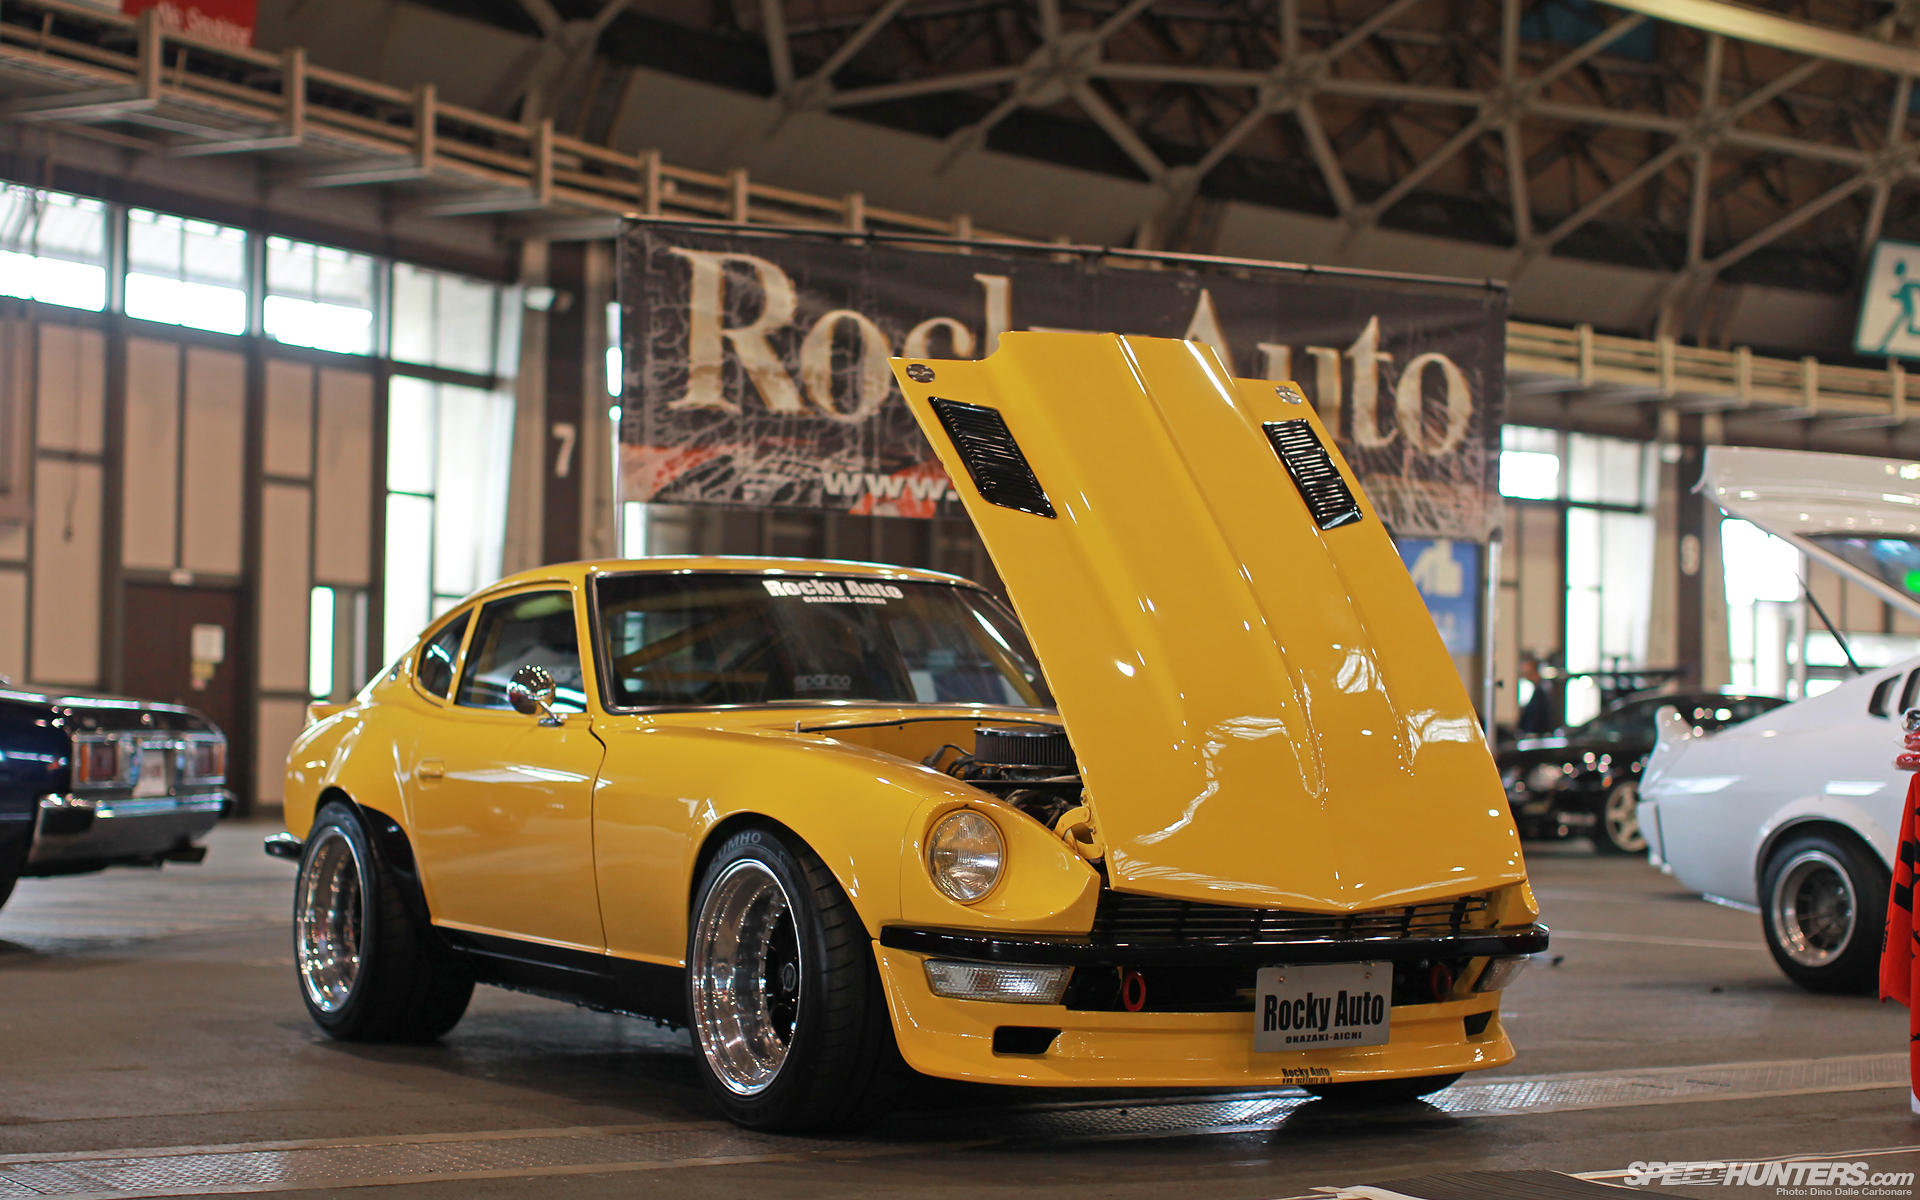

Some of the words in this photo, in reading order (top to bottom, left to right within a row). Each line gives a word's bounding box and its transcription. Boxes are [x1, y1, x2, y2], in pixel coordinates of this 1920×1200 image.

[551, 421, 577, 478] 7
[762, 579, 845, 597] Rocky
[844, 580, 904, 599] Auto
[802, 596, 888, 605] OKAZAKI-AICHI
[794, 674, 851, 691] sparco
[709, 831, 762, 873] KUMHO
[1263, 991, 1331, 1032] Rocky
[1334, 990, 1384, 1027] Auto
[1285, 1031, 1362, 1044] OKAZAKI-AICHI
[1281, 1067, 1309, 1077] Rocky
[1309, 1066, 1331, 1077] Auto
